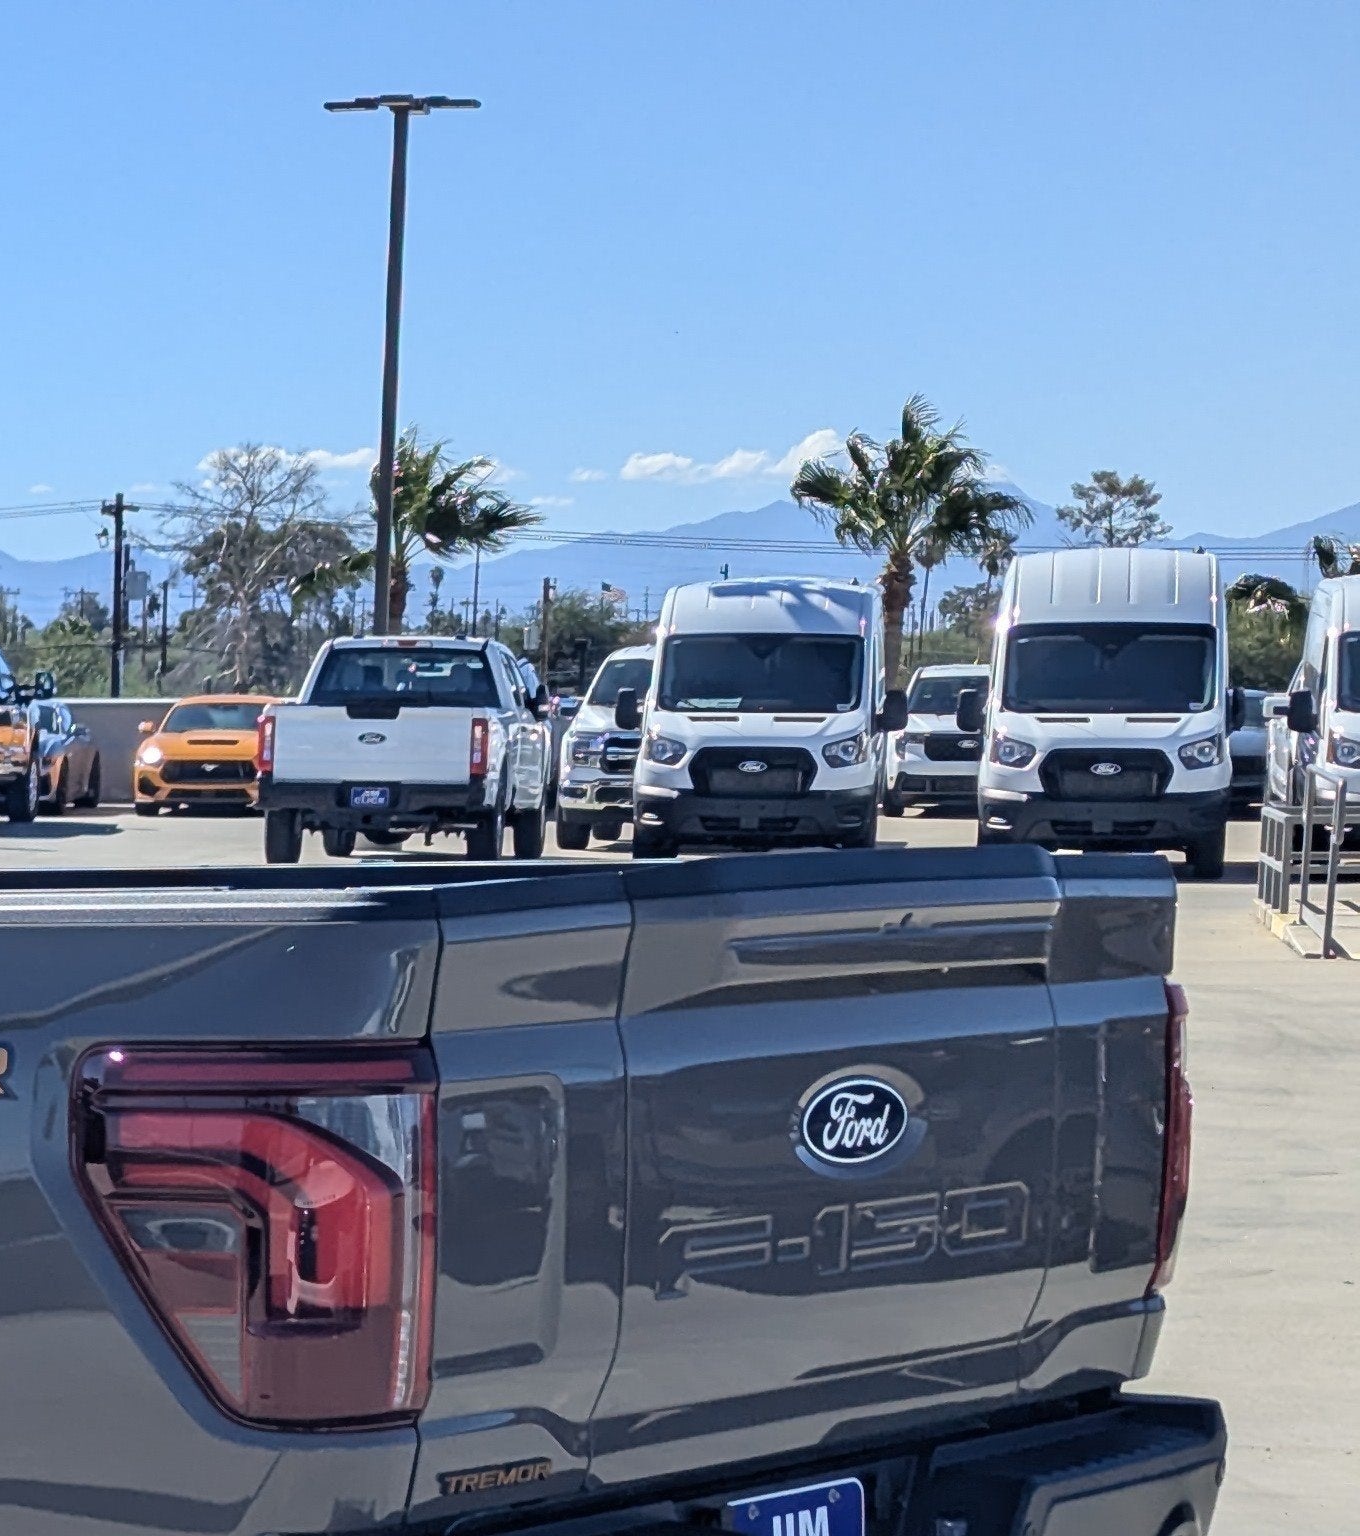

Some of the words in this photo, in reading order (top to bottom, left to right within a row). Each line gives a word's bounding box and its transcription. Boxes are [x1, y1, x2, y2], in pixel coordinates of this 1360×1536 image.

[822, 1091, 890, 1151] Ford
[655, 1181, 1030, 1300] F-150
[446, 1461, 552, 1494] TREMOR
